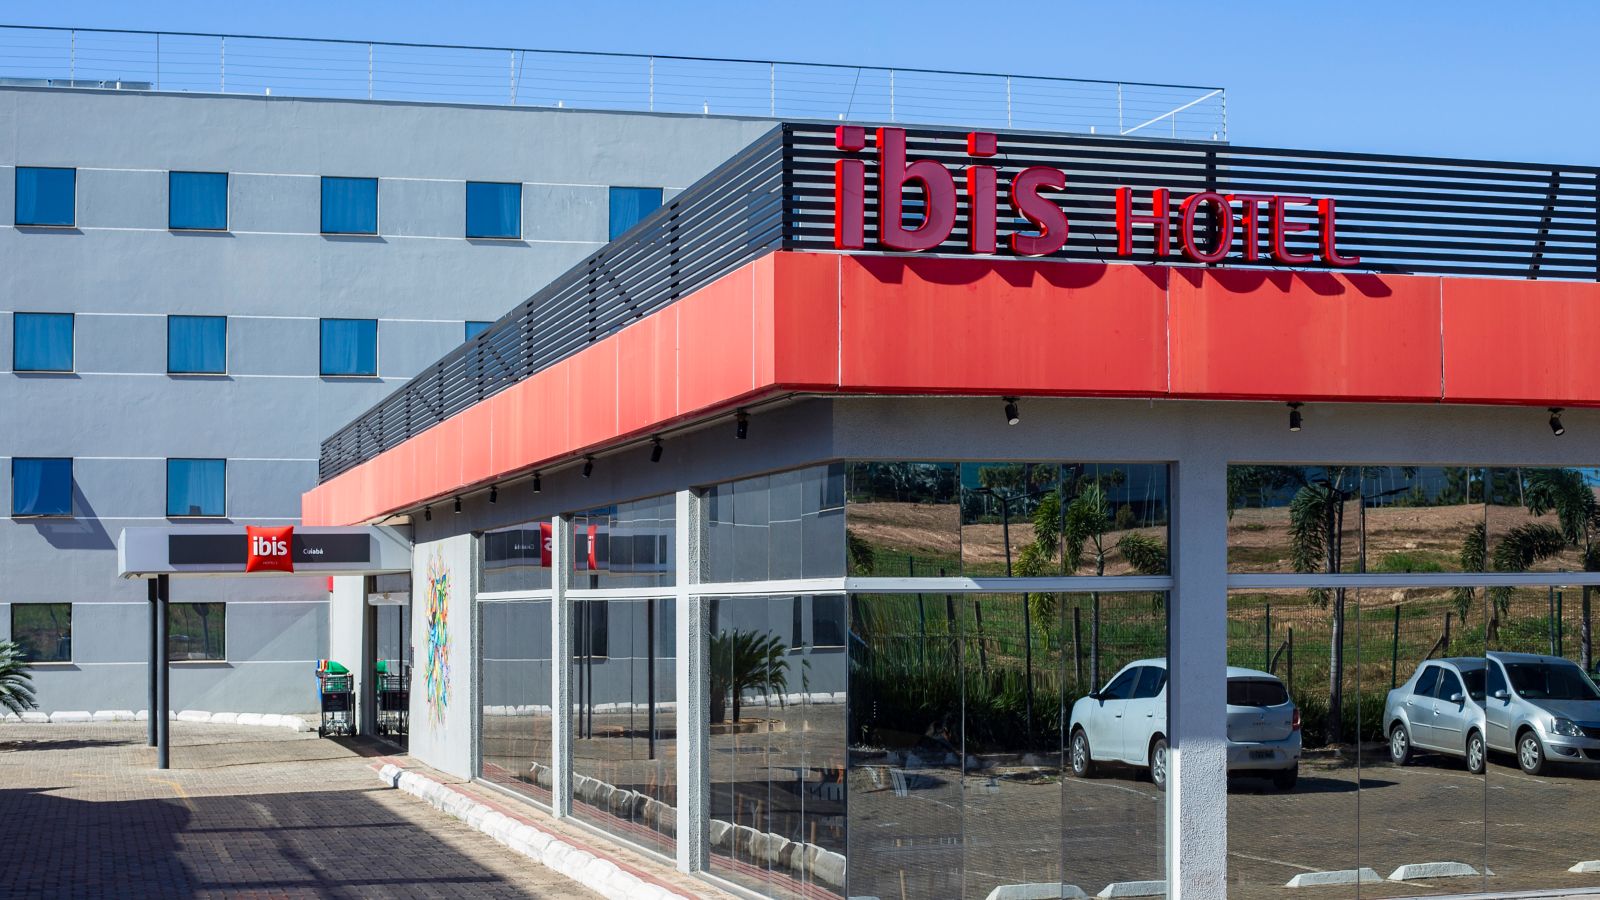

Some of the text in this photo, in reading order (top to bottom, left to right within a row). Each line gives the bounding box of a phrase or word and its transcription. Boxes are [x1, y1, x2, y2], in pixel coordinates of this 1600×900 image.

[835, 125, 1360, 266] ibis HOTEL
[253, 536, 288, 556] ibis
